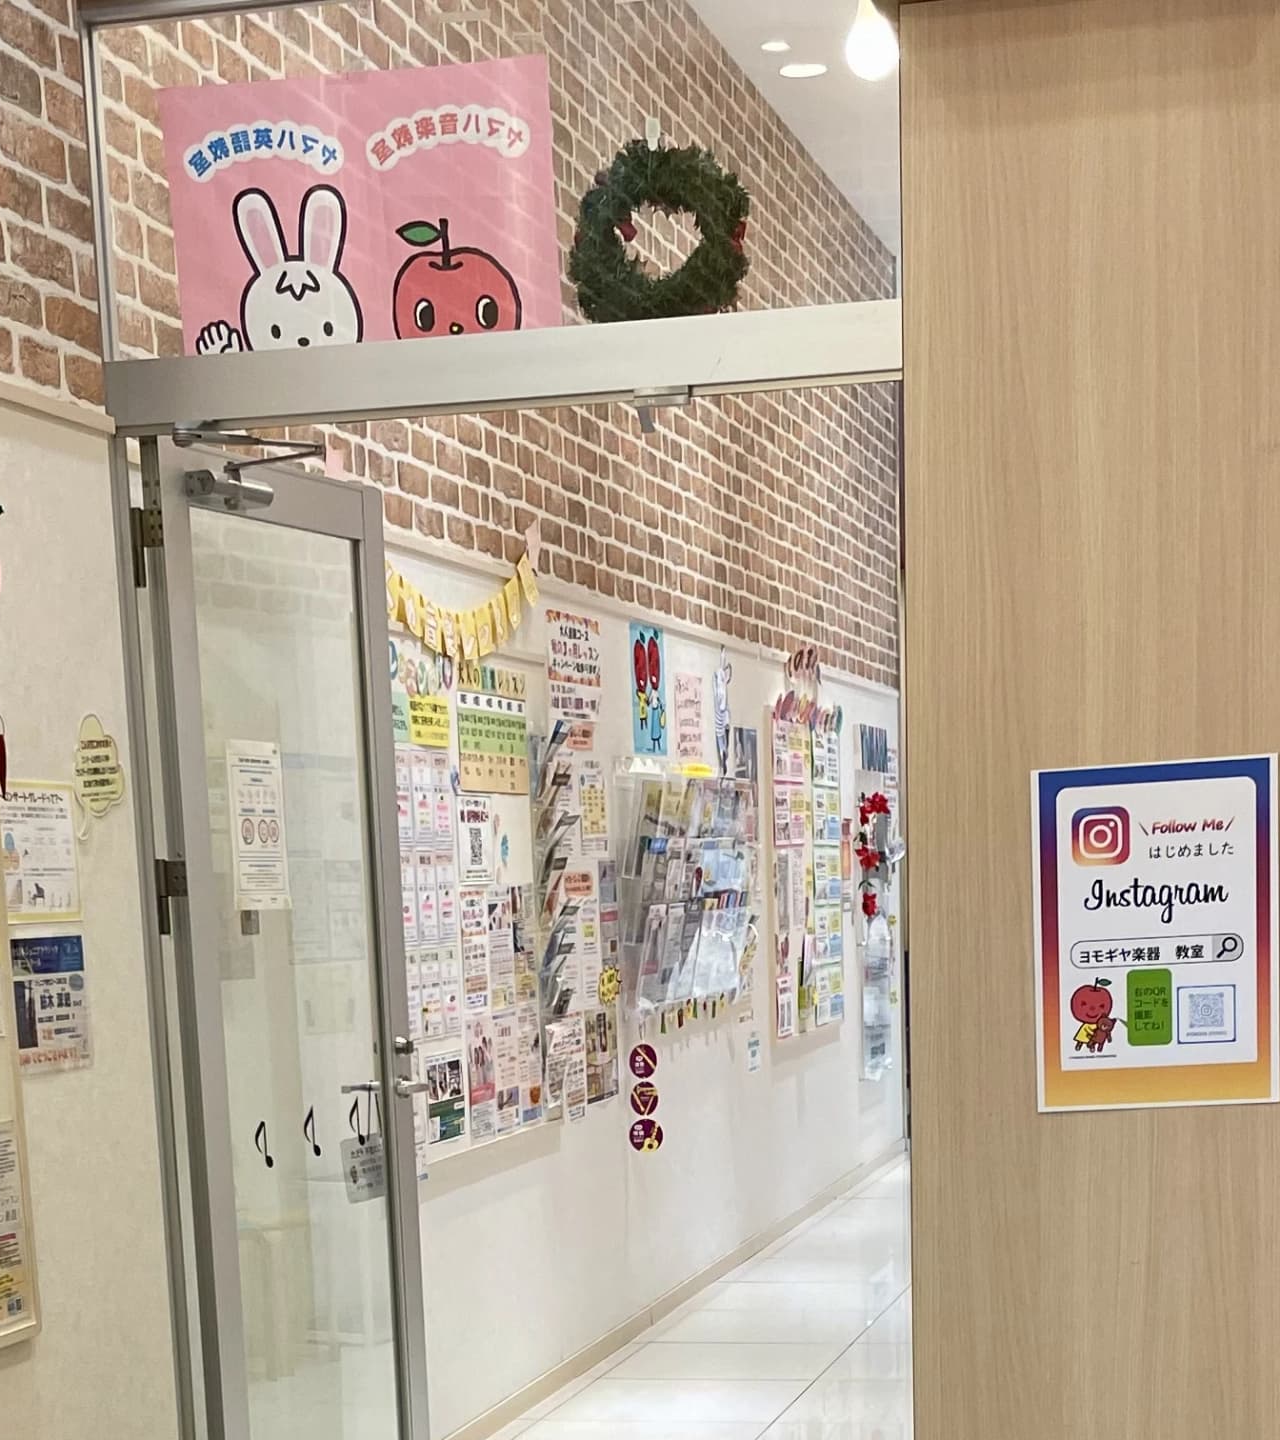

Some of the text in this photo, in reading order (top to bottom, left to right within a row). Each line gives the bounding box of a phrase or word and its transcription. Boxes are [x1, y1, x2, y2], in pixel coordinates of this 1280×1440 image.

[1151, 817, 1226, 836] Follow Me
[1148, 841, 1235, 860] はじめました
[1083, 877, 1230, 925] Instagram
[1078, 944, 1205, 965] ヨモギヤ楽器 教室
